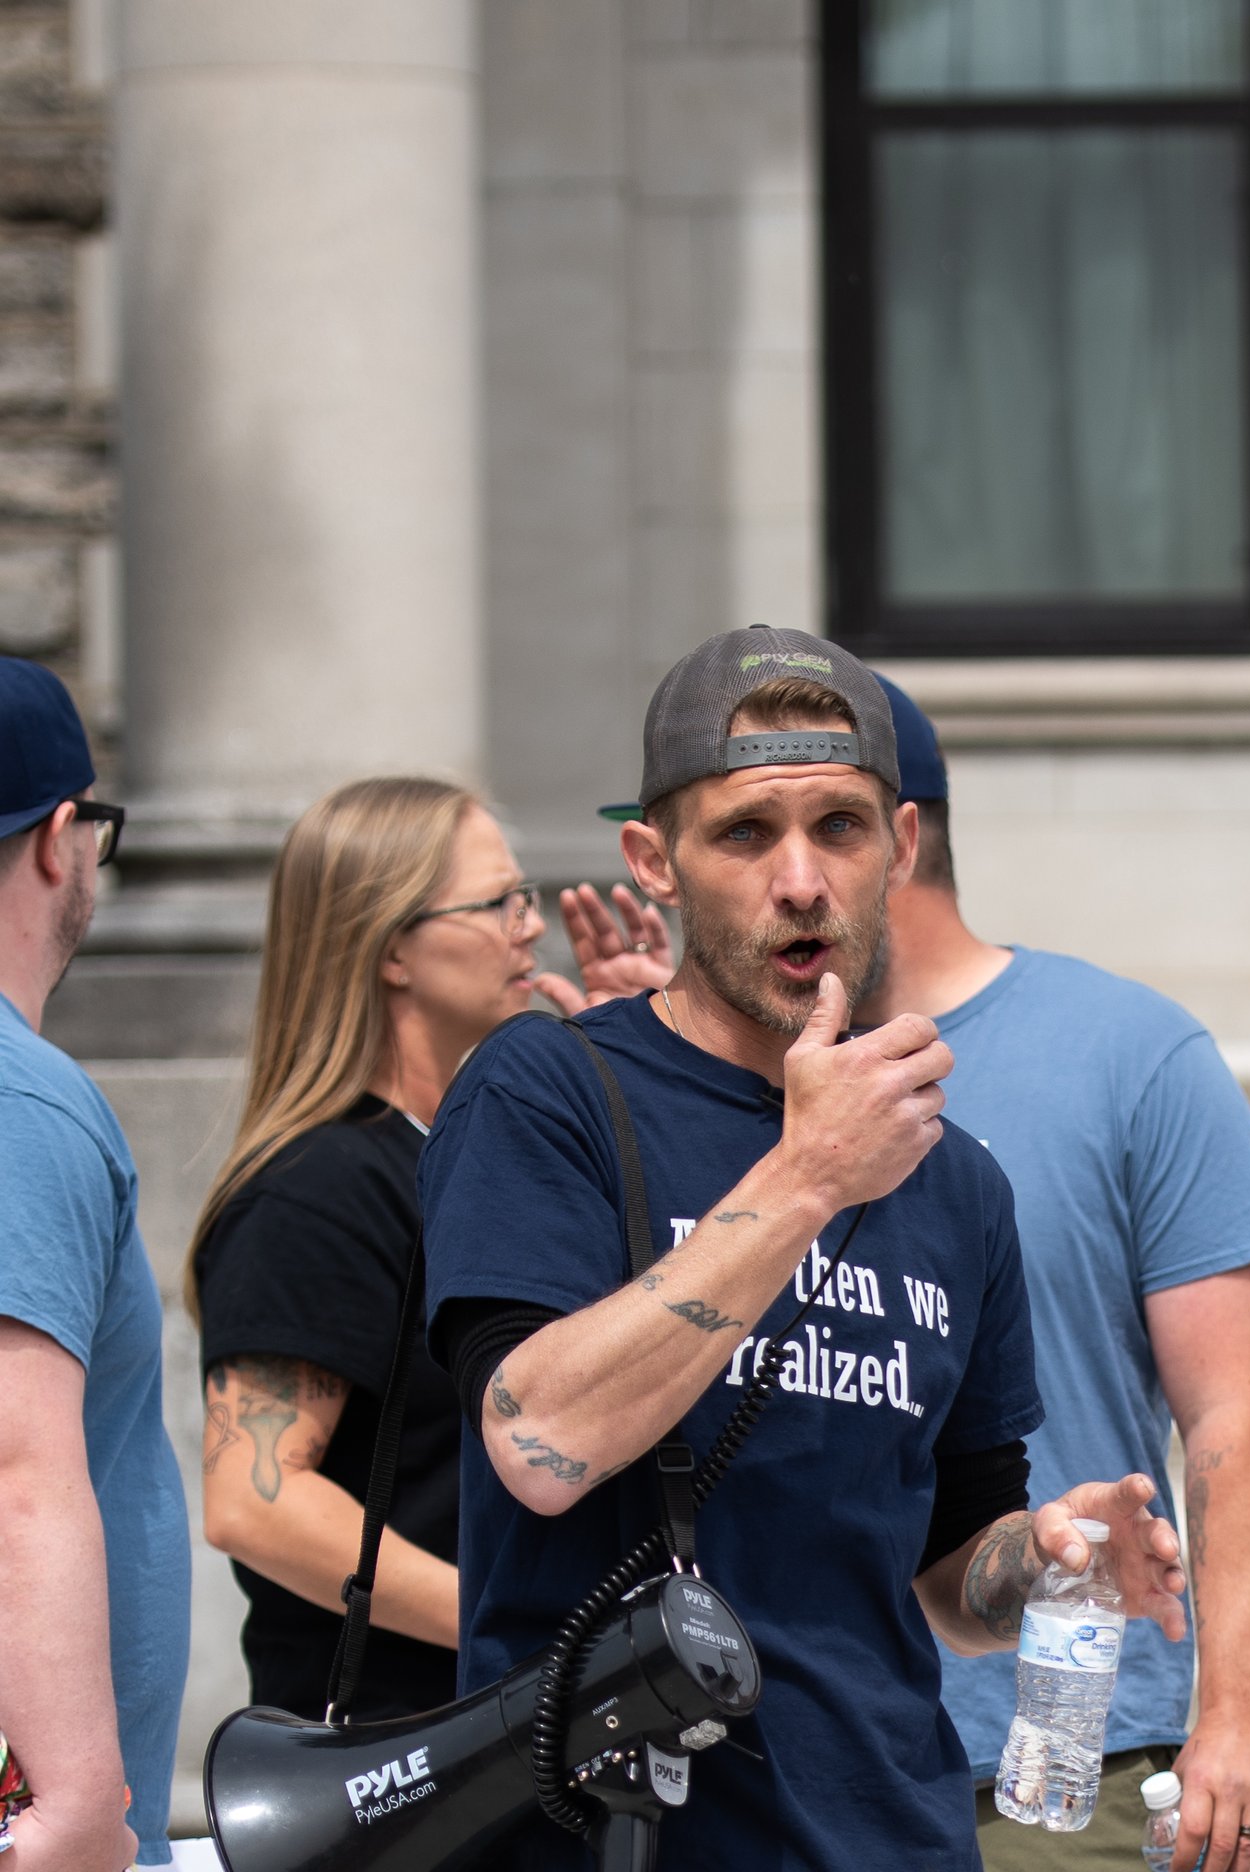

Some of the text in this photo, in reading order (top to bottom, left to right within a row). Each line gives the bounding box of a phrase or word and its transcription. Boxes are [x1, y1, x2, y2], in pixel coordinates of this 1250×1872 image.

[903, 1275, 949, 1337] we
[683, 1588, 712, 1609] PYLE
[681, 1623, 739, 1650] PMP561LTB
[345, 1747, 430, 1808] PYLE
[655, 1763, 682, 1785] PYLE
[355, 1781, 437, 1825] PyleUSA.com
